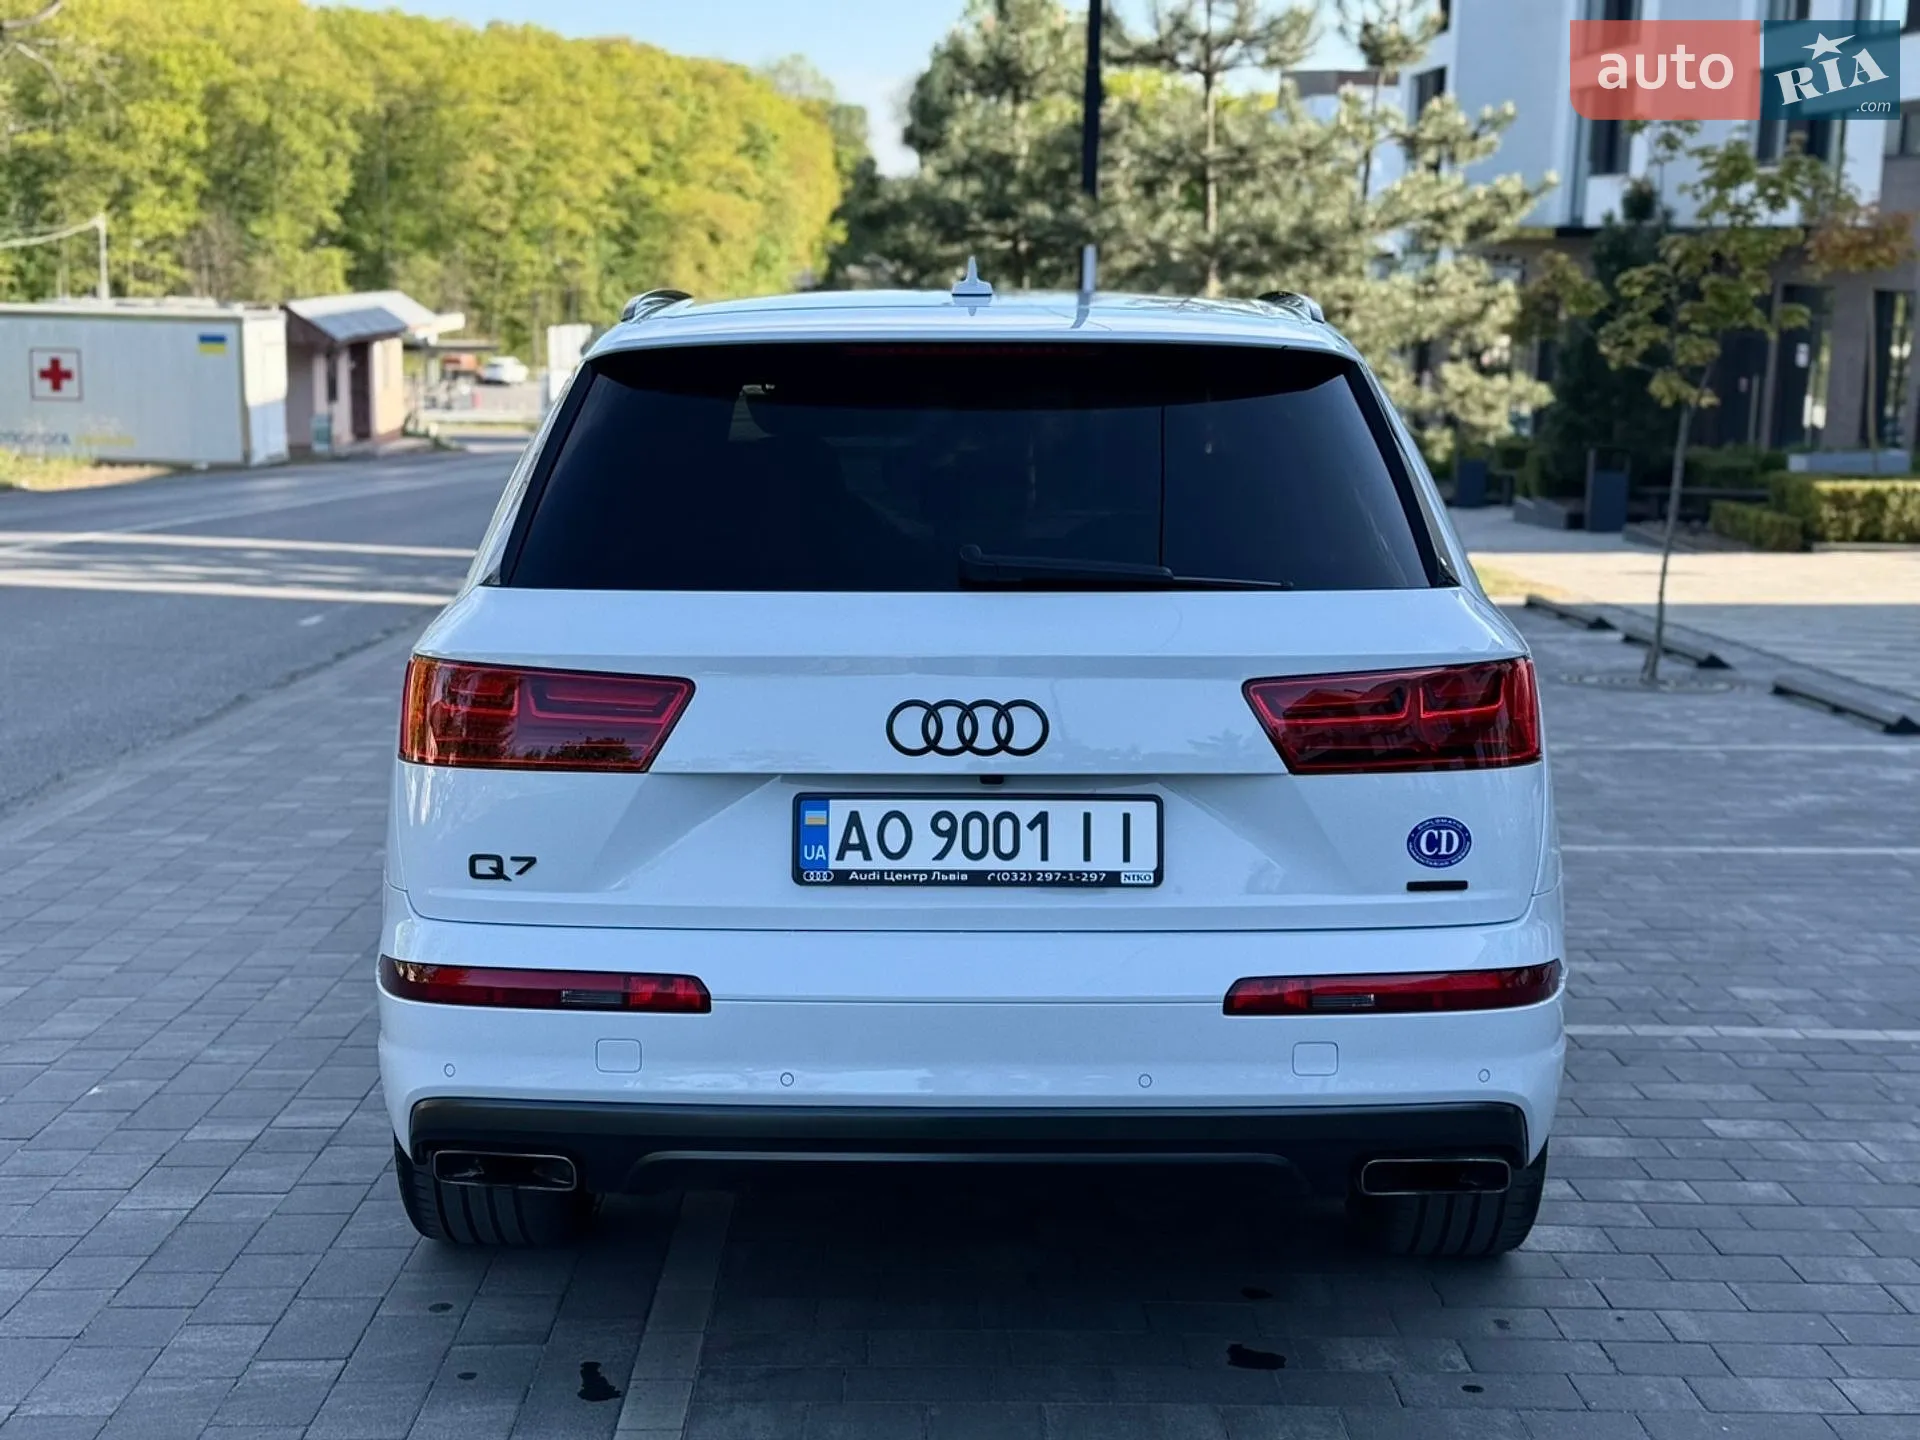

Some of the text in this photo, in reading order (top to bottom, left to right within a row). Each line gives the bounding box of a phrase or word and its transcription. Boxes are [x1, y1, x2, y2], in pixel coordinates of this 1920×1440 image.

[929, 810, 1050, 862] 9001
[1419, 829, 1460, 856] CD
[803, 844, 827, 861] UA
[468, 853, 538, 882] Q7
[849, 870, 880, 881] Audi
[883, 870, 928, 883] Центр
[930, 870, 968, 881] Львів
[1035, 871, 1107, 882] 297-1-297
[1122, 873, 1153, 883] NIKO
